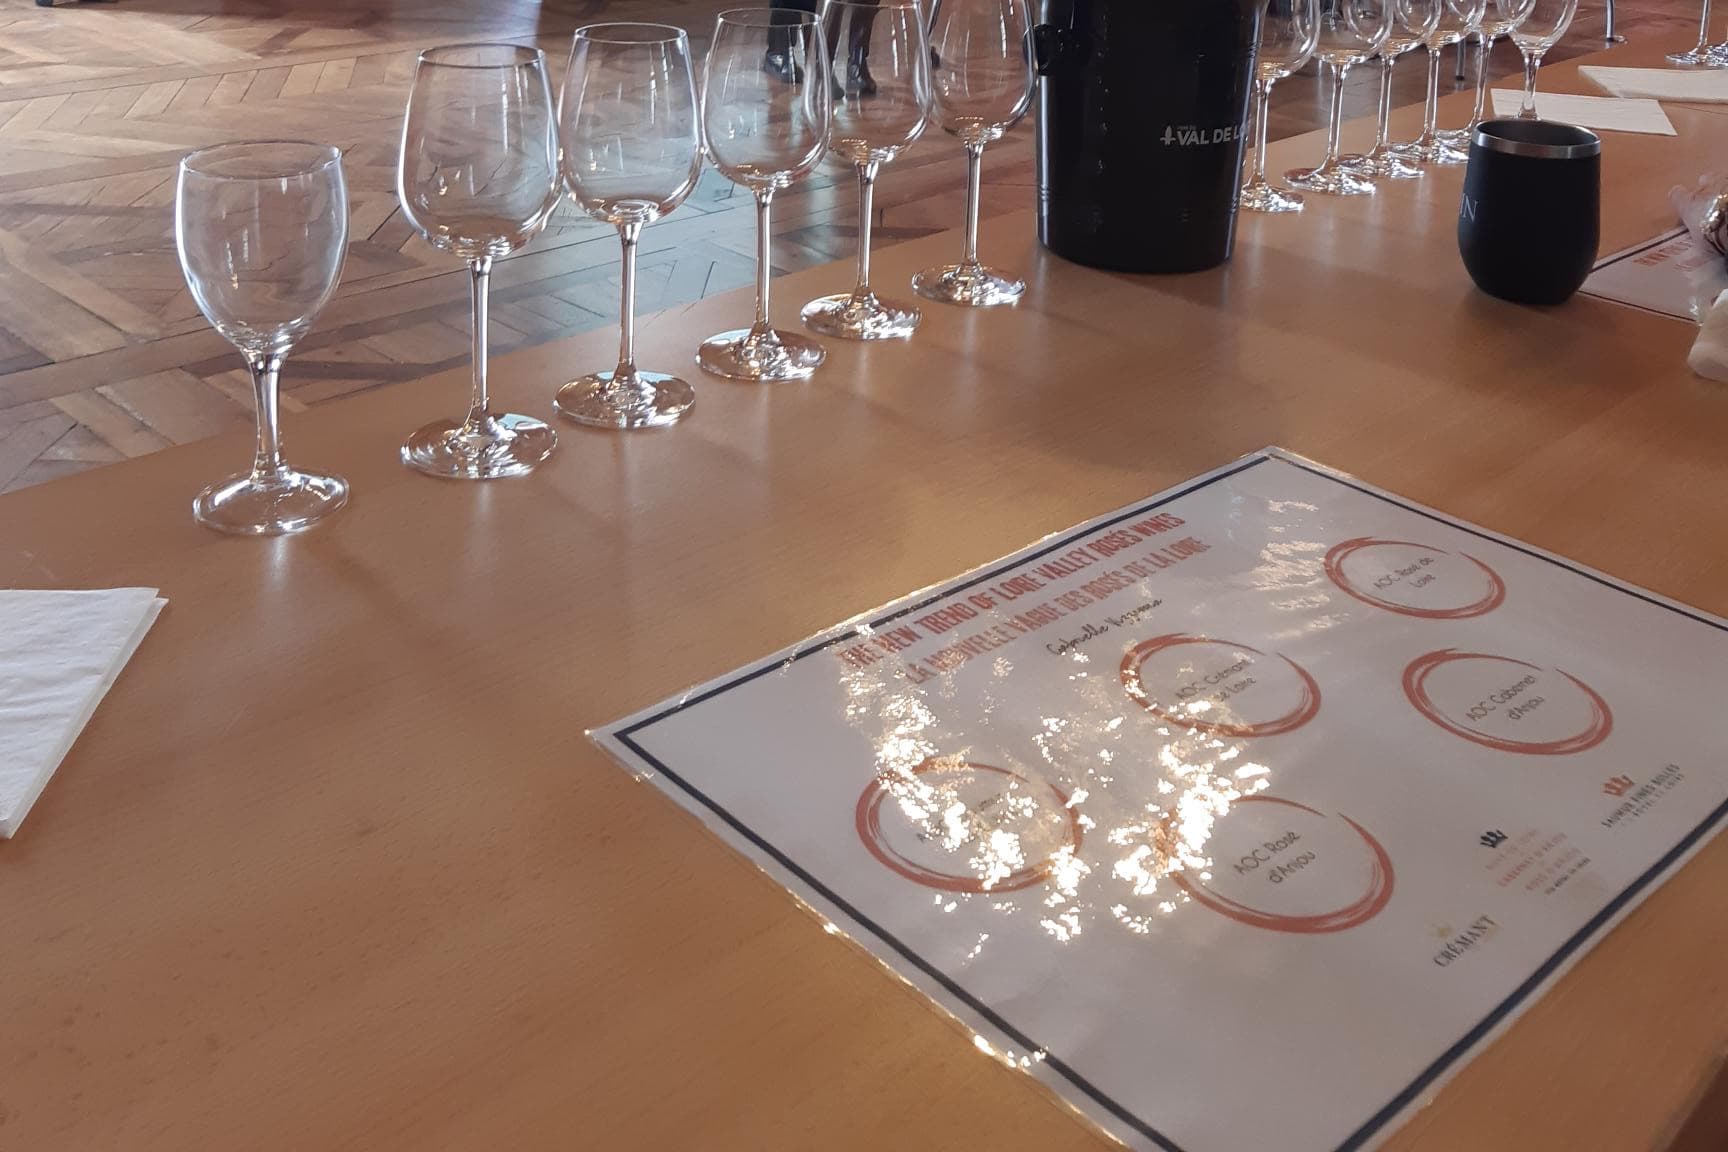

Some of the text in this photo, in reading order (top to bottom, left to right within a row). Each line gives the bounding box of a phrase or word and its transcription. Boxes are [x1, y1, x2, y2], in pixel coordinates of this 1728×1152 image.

[1177, 129, 1210, 146] VAL
[1212, 126, 1233, 145] DE
[913, 601, 980, 635] TREND
[967, 593, 997, 614] OF
[995, 572, 1047, 602] LOIRE
[1032, 547, 1100, 582] VALLEY
[1130, 511, 1187, 538] WINES
[1003, 602, 1068, 640] VAGUE
[1053, 590, 1092, 612] DES
[1466, 673, 1538, 722] AOC Cabernet
[1233, 849, 1271, 876] AOC
[1268, 850, 1316, 885] d'Anjou
[1432, 914, 1496, 968] CRÉMANT
